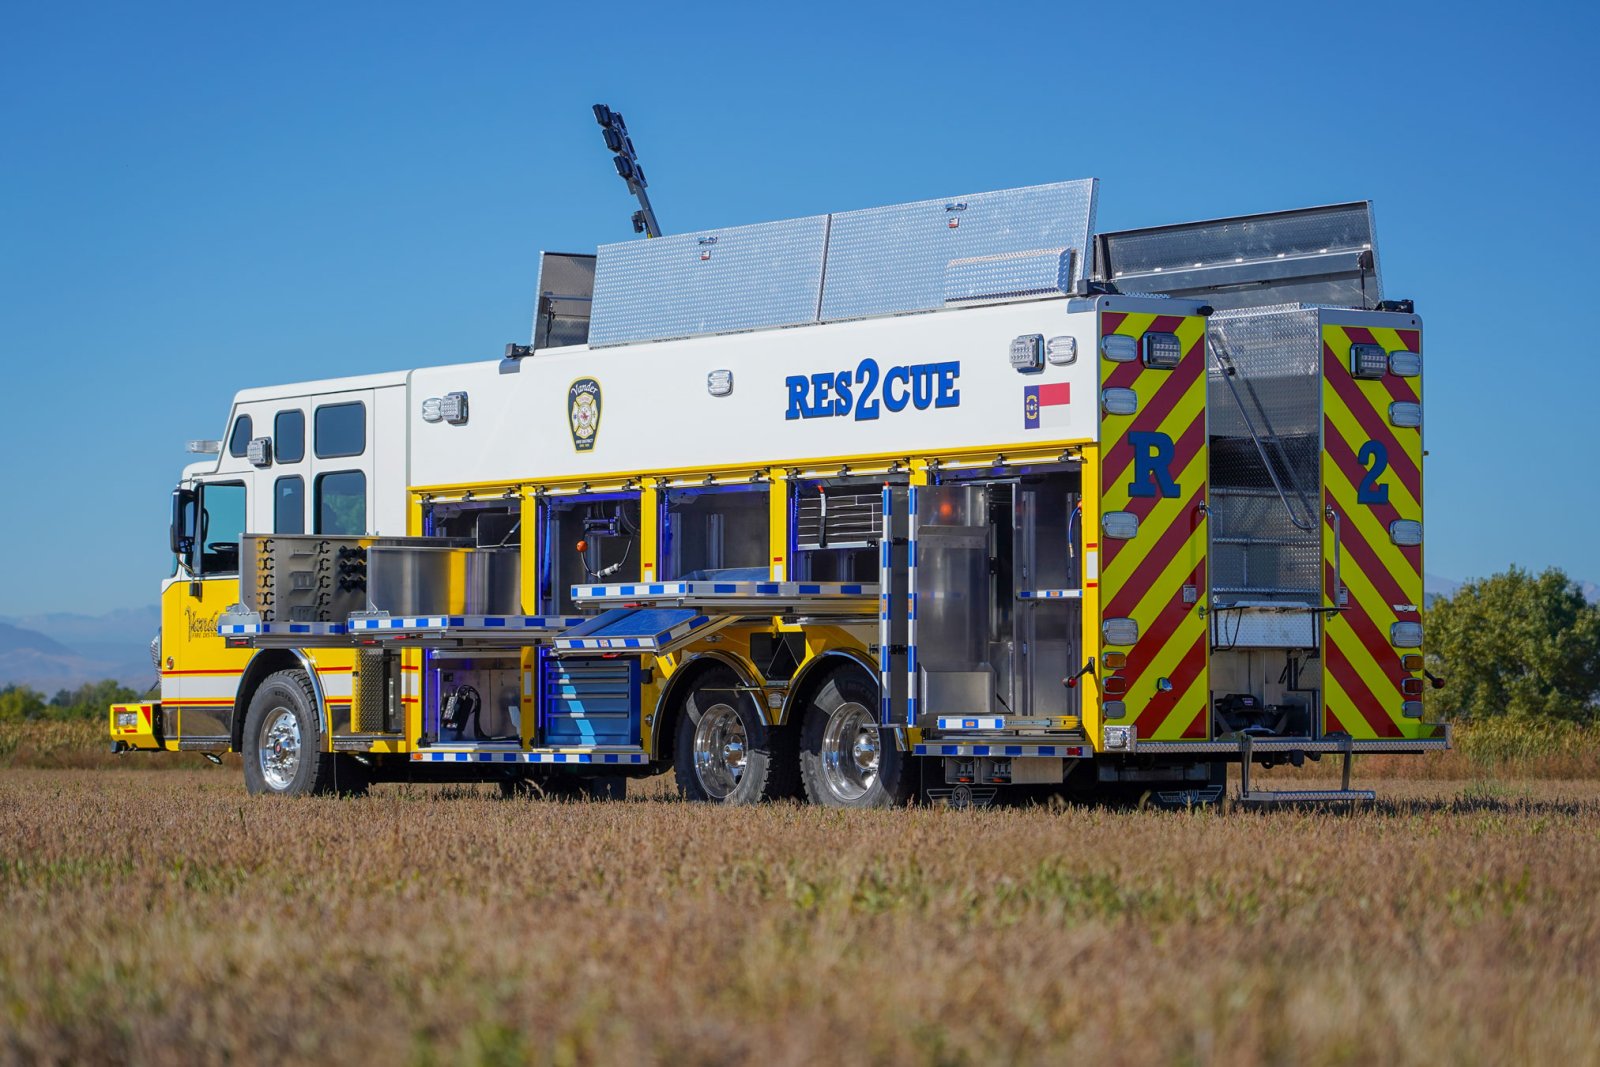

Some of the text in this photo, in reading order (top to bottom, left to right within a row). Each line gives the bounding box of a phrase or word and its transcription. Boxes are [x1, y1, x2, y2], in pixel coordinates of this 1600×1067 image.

[570, 381, 598, 396] Vander
[785, 358, 960, 421] RES2CUE
[1128, 431, 1181, 498] R
[1357, 439, 1389, 505] 2
[184, 606, 219, 642] Vande
